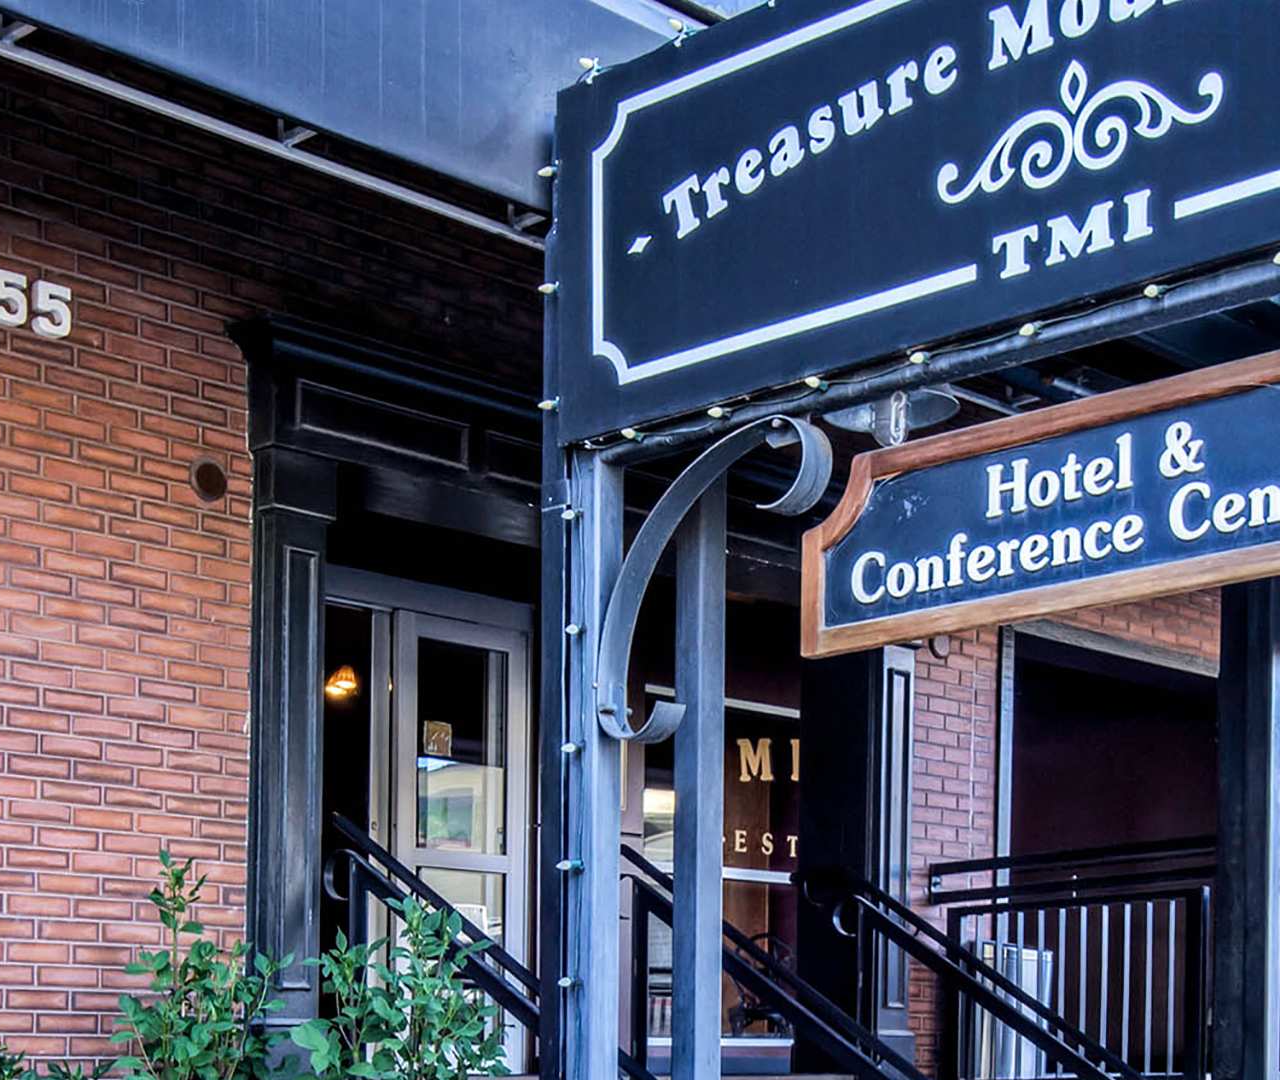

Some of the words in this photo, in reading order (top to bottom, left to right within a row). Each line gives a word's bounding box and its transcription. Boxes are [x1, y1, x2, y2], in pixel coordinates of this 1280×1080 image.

[663, 46, 958, 240] Treasure
[993, 189, 1154, 280] TMI
[986, 433, 1133, 518] Hotel
[1159, 421, 1206, 477] &
[851, 515, 1145, 604] Conference
